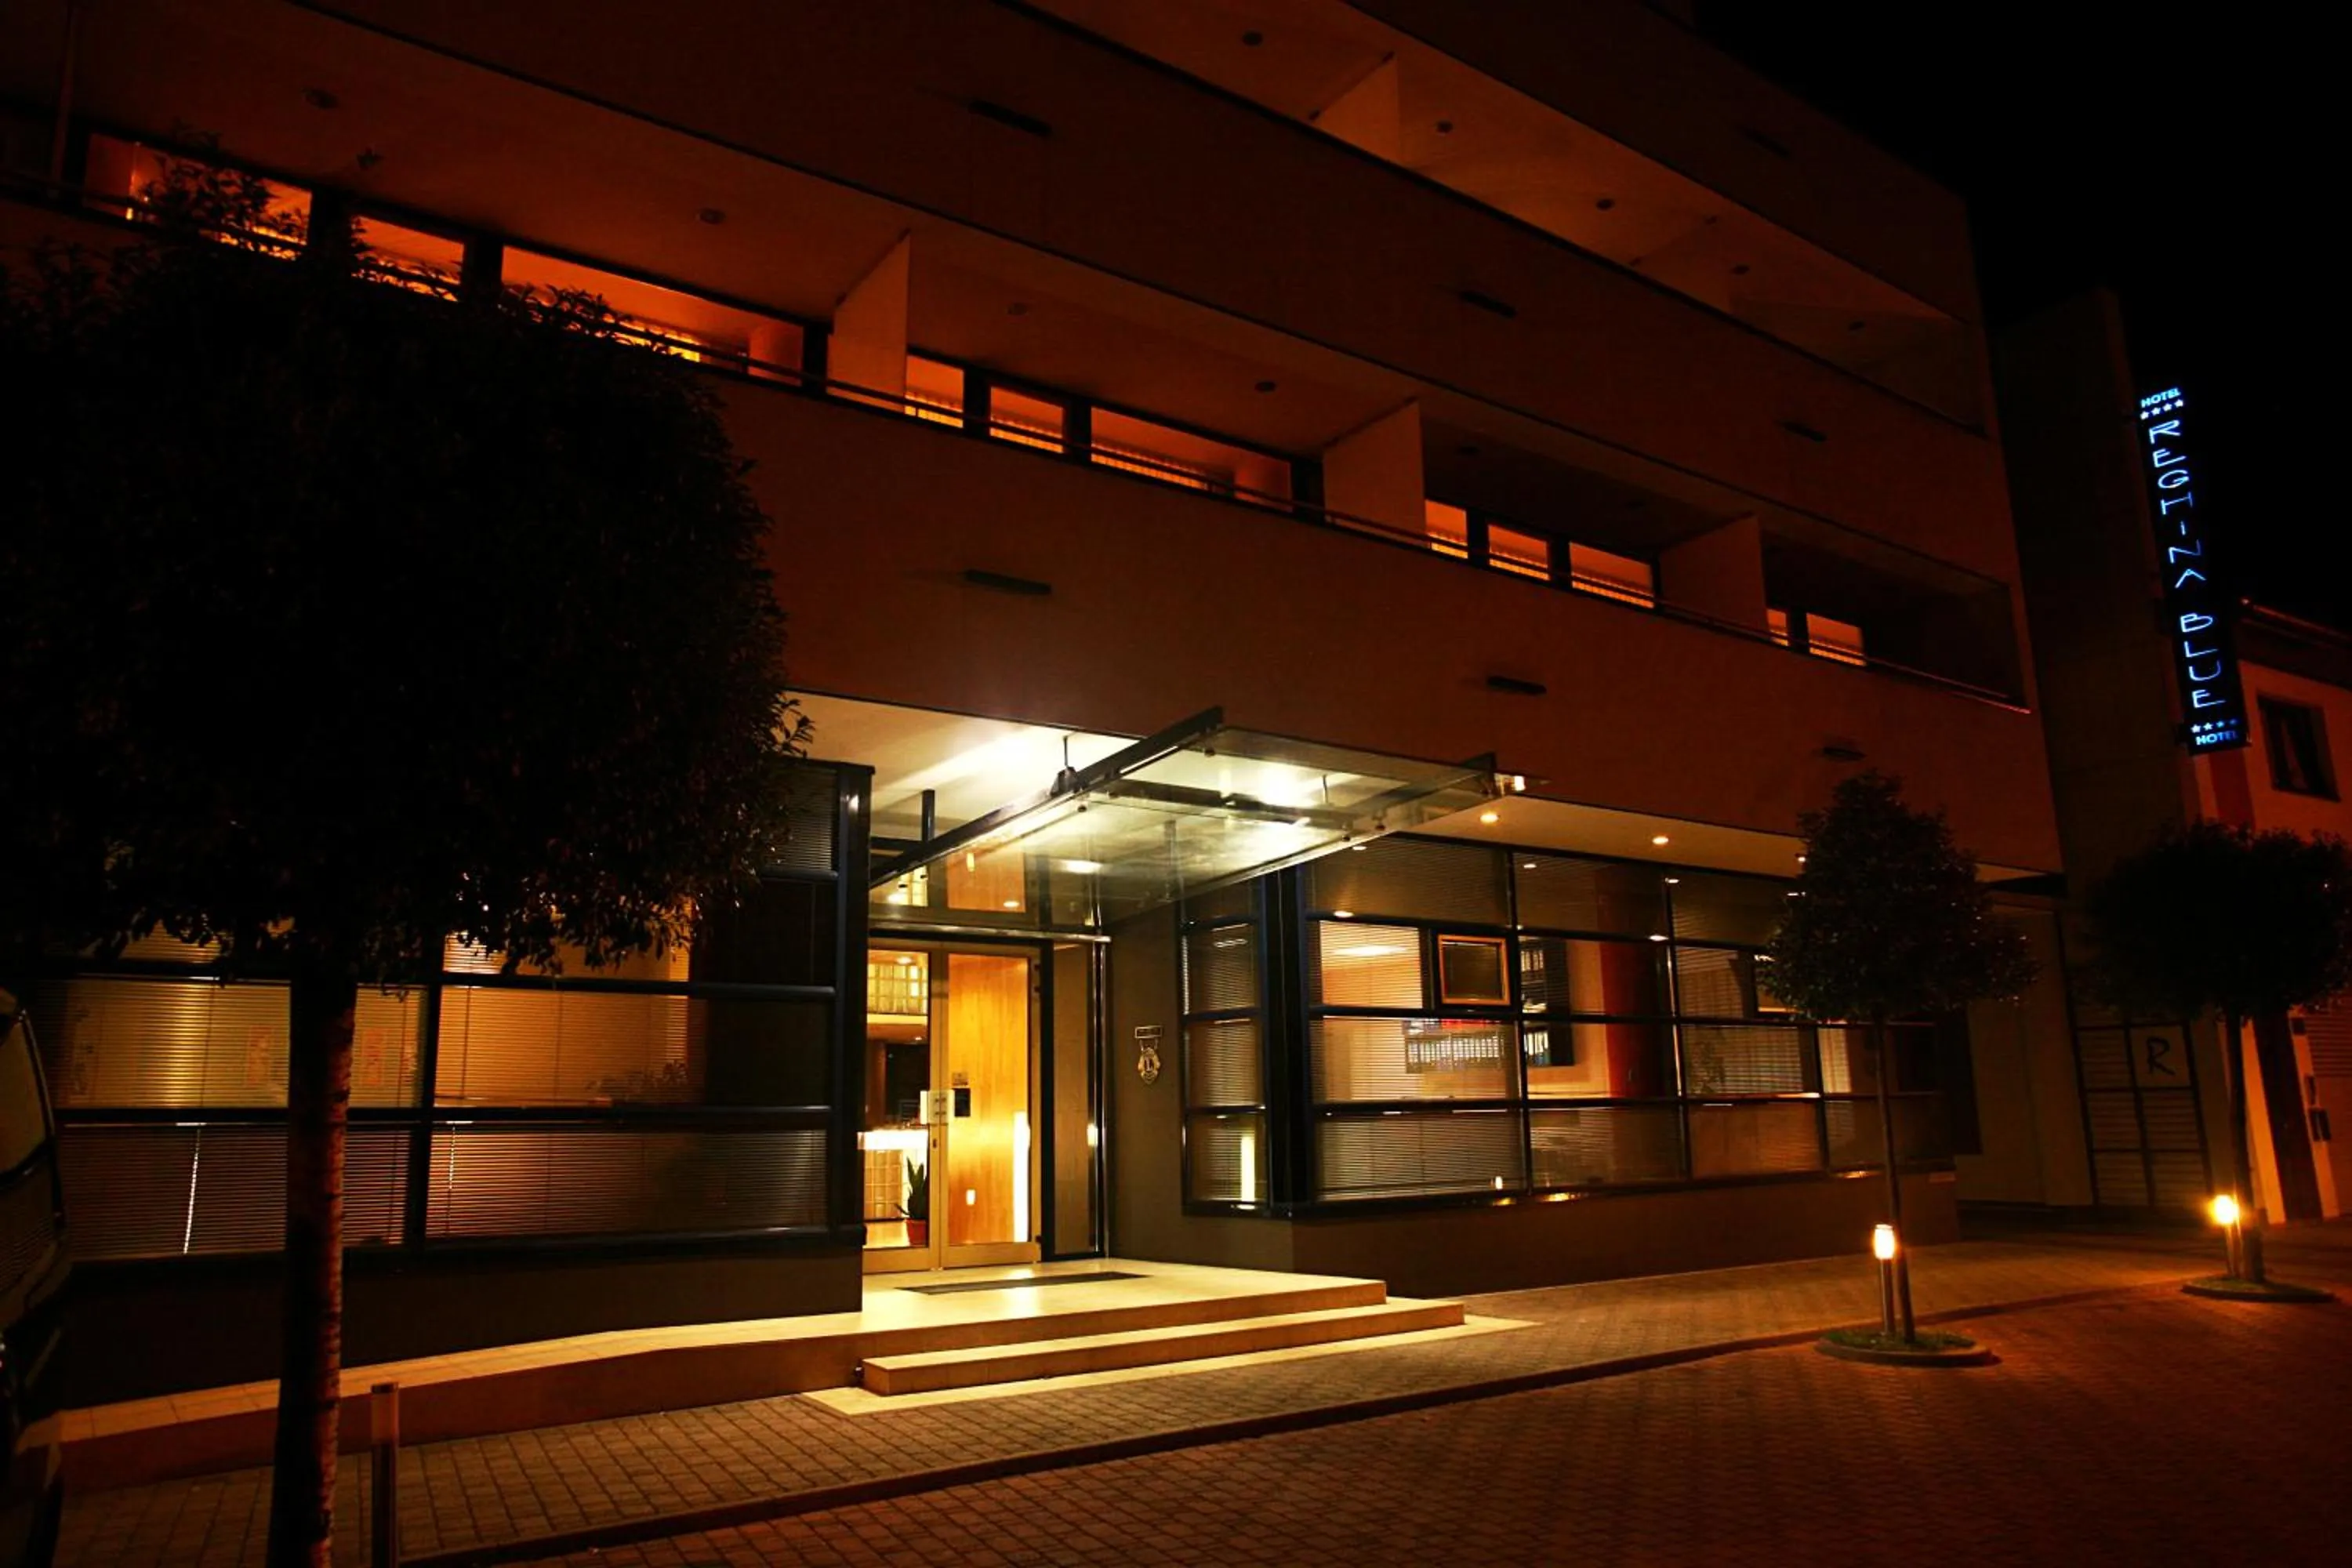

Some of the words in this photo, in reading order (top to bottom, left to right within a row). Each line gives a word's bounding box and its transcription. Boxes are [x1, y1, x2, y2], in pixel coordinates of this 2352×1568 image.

[2140, 387, 2181, 408] HOTEL
[2180, 612, 2227, 708] BLUE
[2196, 730, 2238, 746] HOTEL
[2146, 1037, 2176, 1076] R
